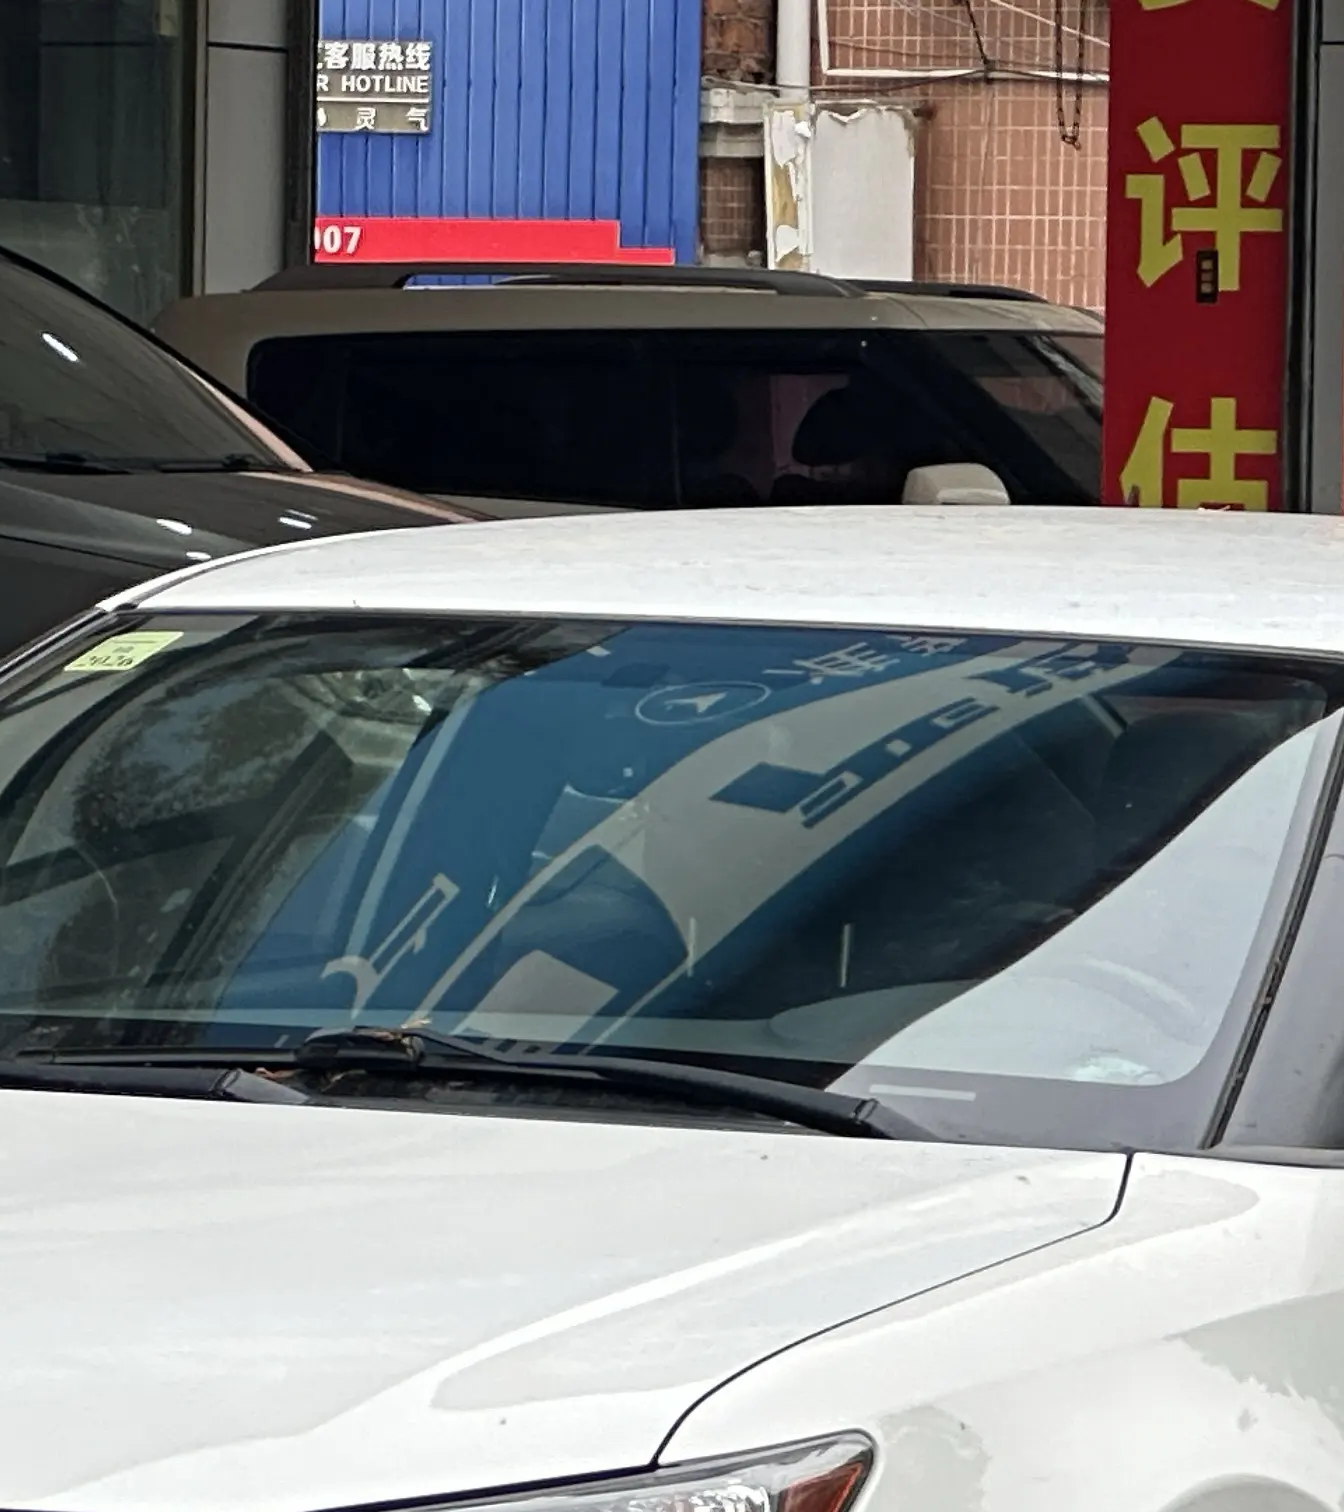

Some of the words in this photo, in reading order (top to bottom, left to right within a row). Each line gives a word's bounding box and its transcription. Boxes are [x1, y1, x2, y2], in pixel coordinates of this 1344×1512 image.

[317, 41, 430, 70] 客服热线
[341, 74, 429, 93] HOTLINE
[1120, 0, 1284, 510] 评估
